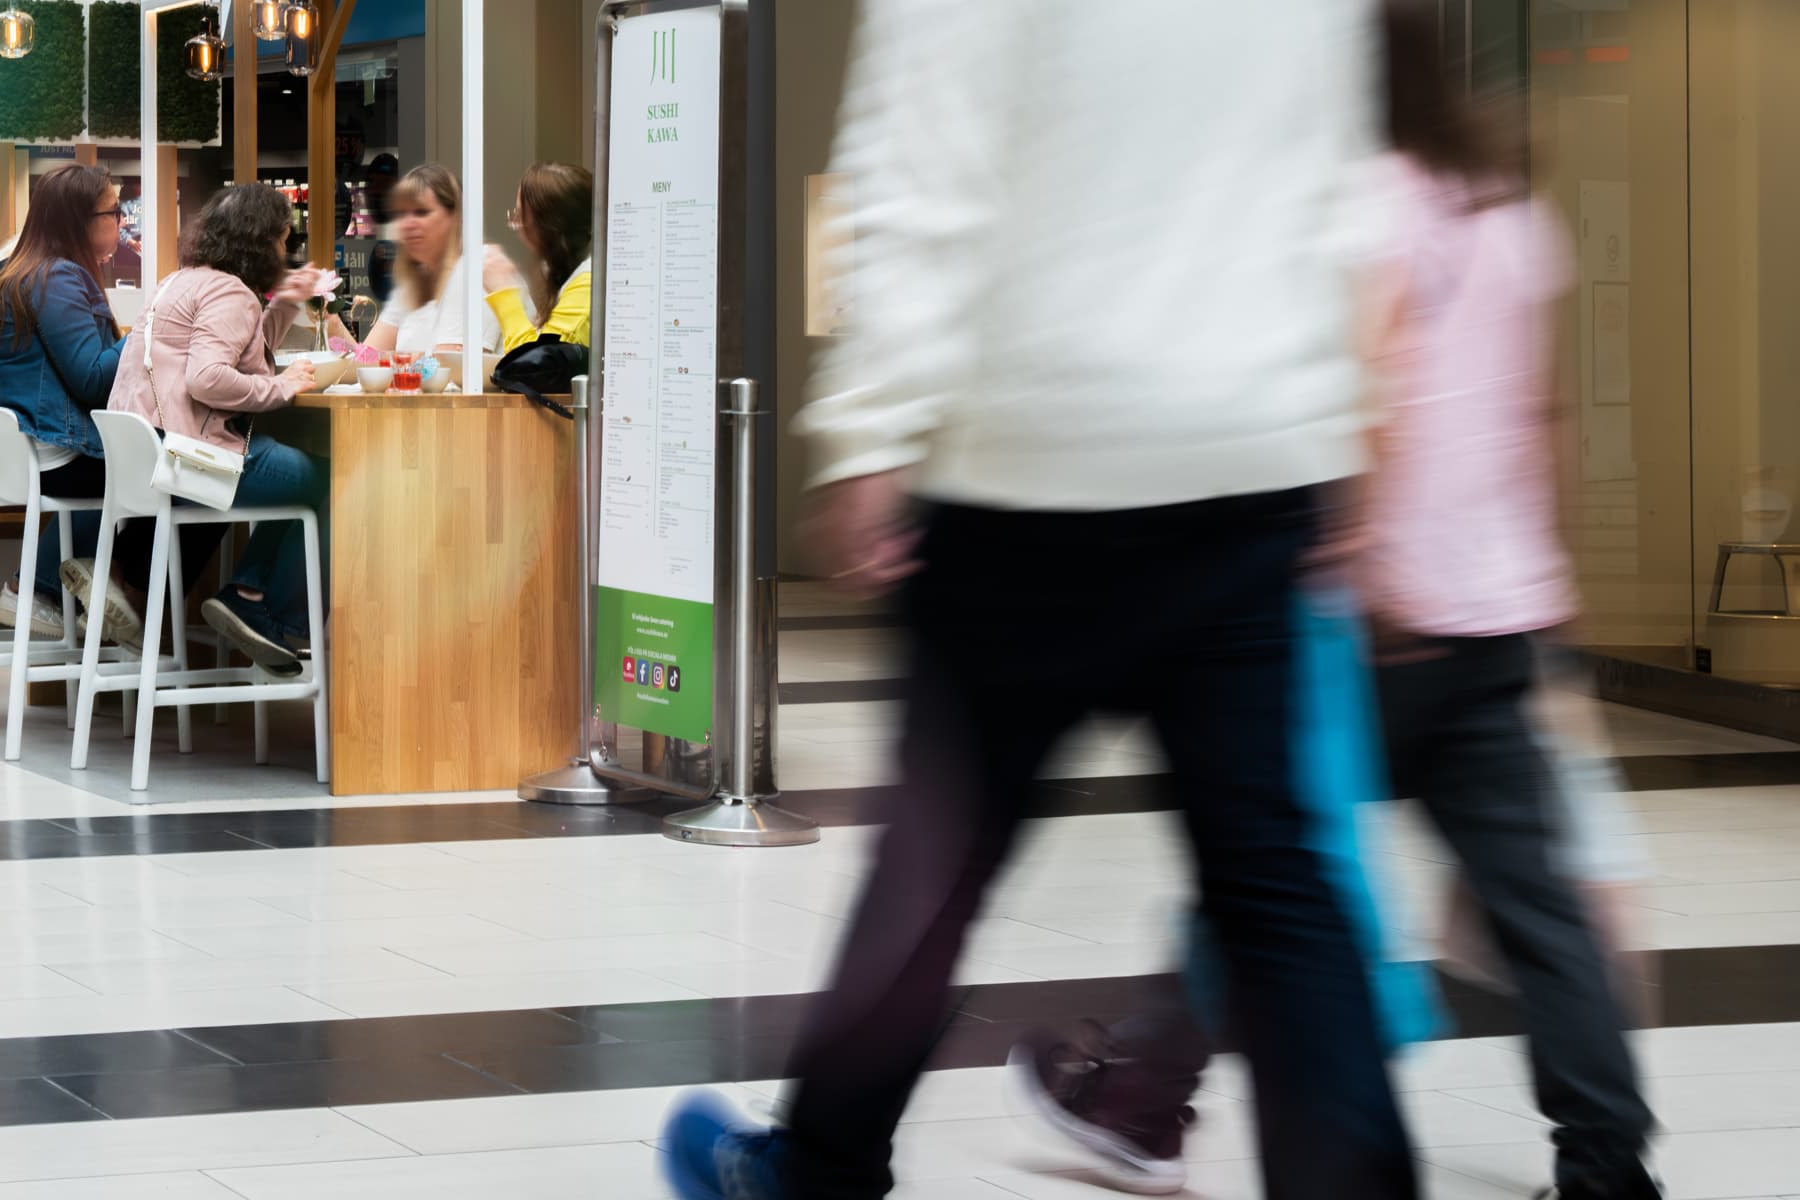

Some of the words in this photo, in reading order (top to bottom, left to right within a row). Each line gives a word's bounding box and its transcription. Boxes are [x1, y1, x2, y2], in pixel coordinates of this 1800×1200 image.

[646, 102, 679, 120] SUSHI
[646, 127, 679, 144] KAWA
[652, 181, 672, 193] MENY
